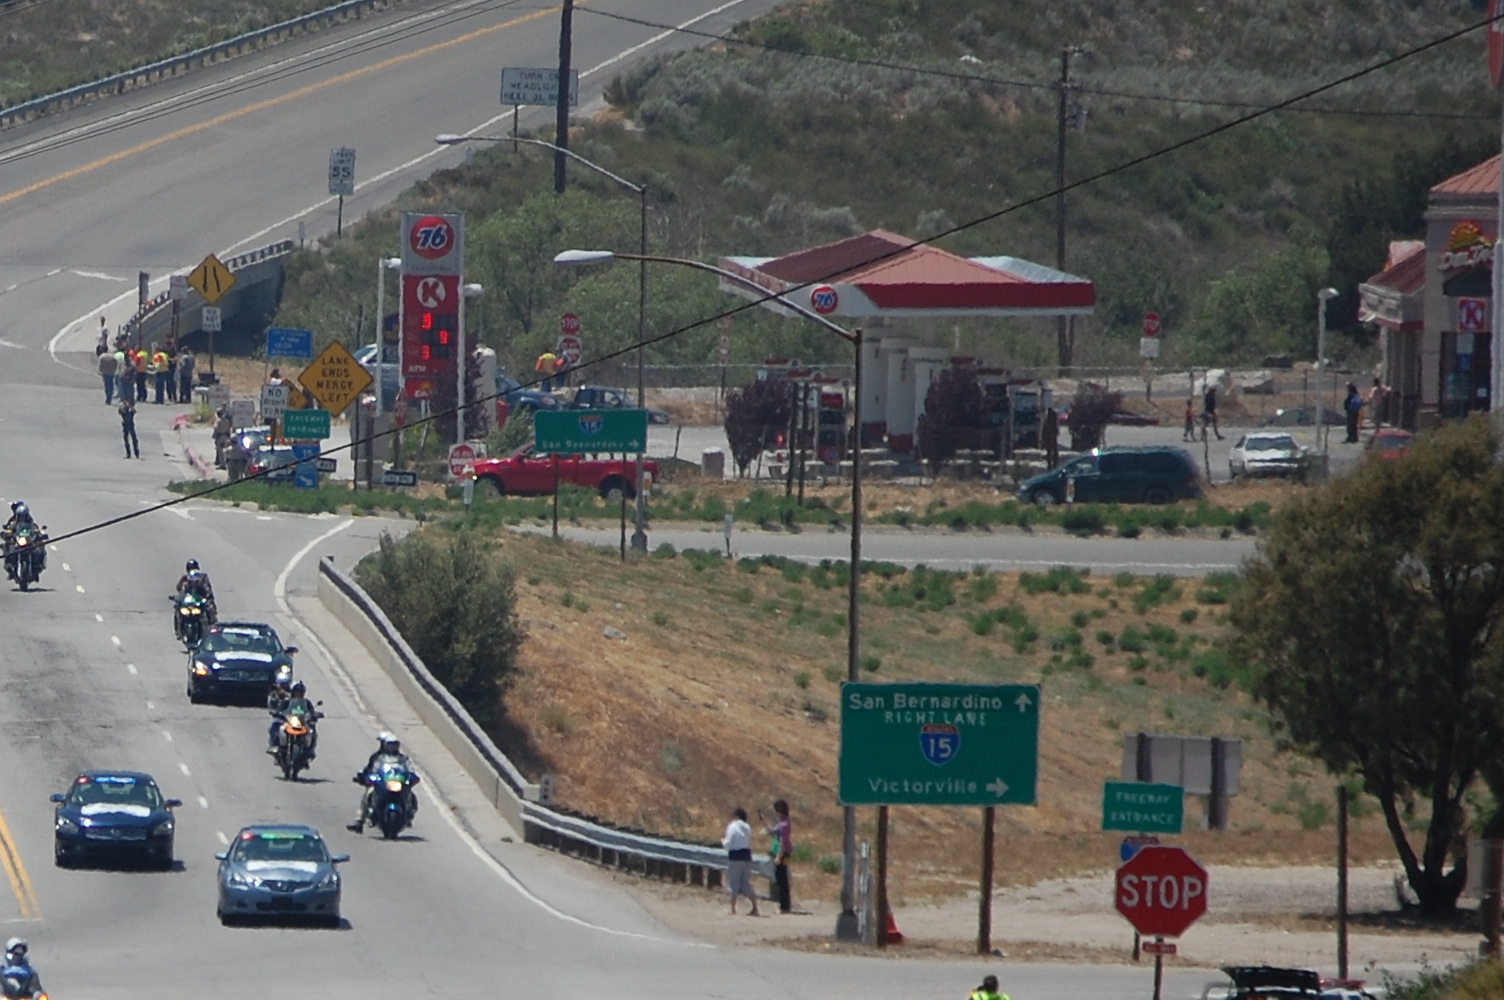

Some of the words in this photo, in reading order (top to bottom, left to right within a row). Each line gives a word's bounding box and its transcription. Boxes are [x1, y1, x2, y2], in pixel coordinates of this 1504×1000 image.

[332, 166, 351, 178] 55
[417, 225, 448, 250] 76
[816, 291, 835, 308] 76
[322, 356, 349, 365] LANE
[322, 369, 350, 377] ENDS
[316, 380, 354, 390] MERGE
[268, 388, 282, 397] NO
[322, 393, 348, 402] LEFT
[542, 440, 561, 449] San
[566, 440, 624, 449] Bernardino
[849, 693, 885, 710] San
[894, 693, 1003, 710] Bernardino
[884, 711, 935, 724] RIGHT
[944, 712, 987, 726] LANE
[929, 738, 952, 758] 15
[869, 778, 978, 794] Victorville
[1121, 874, 1203, 911] STOP
